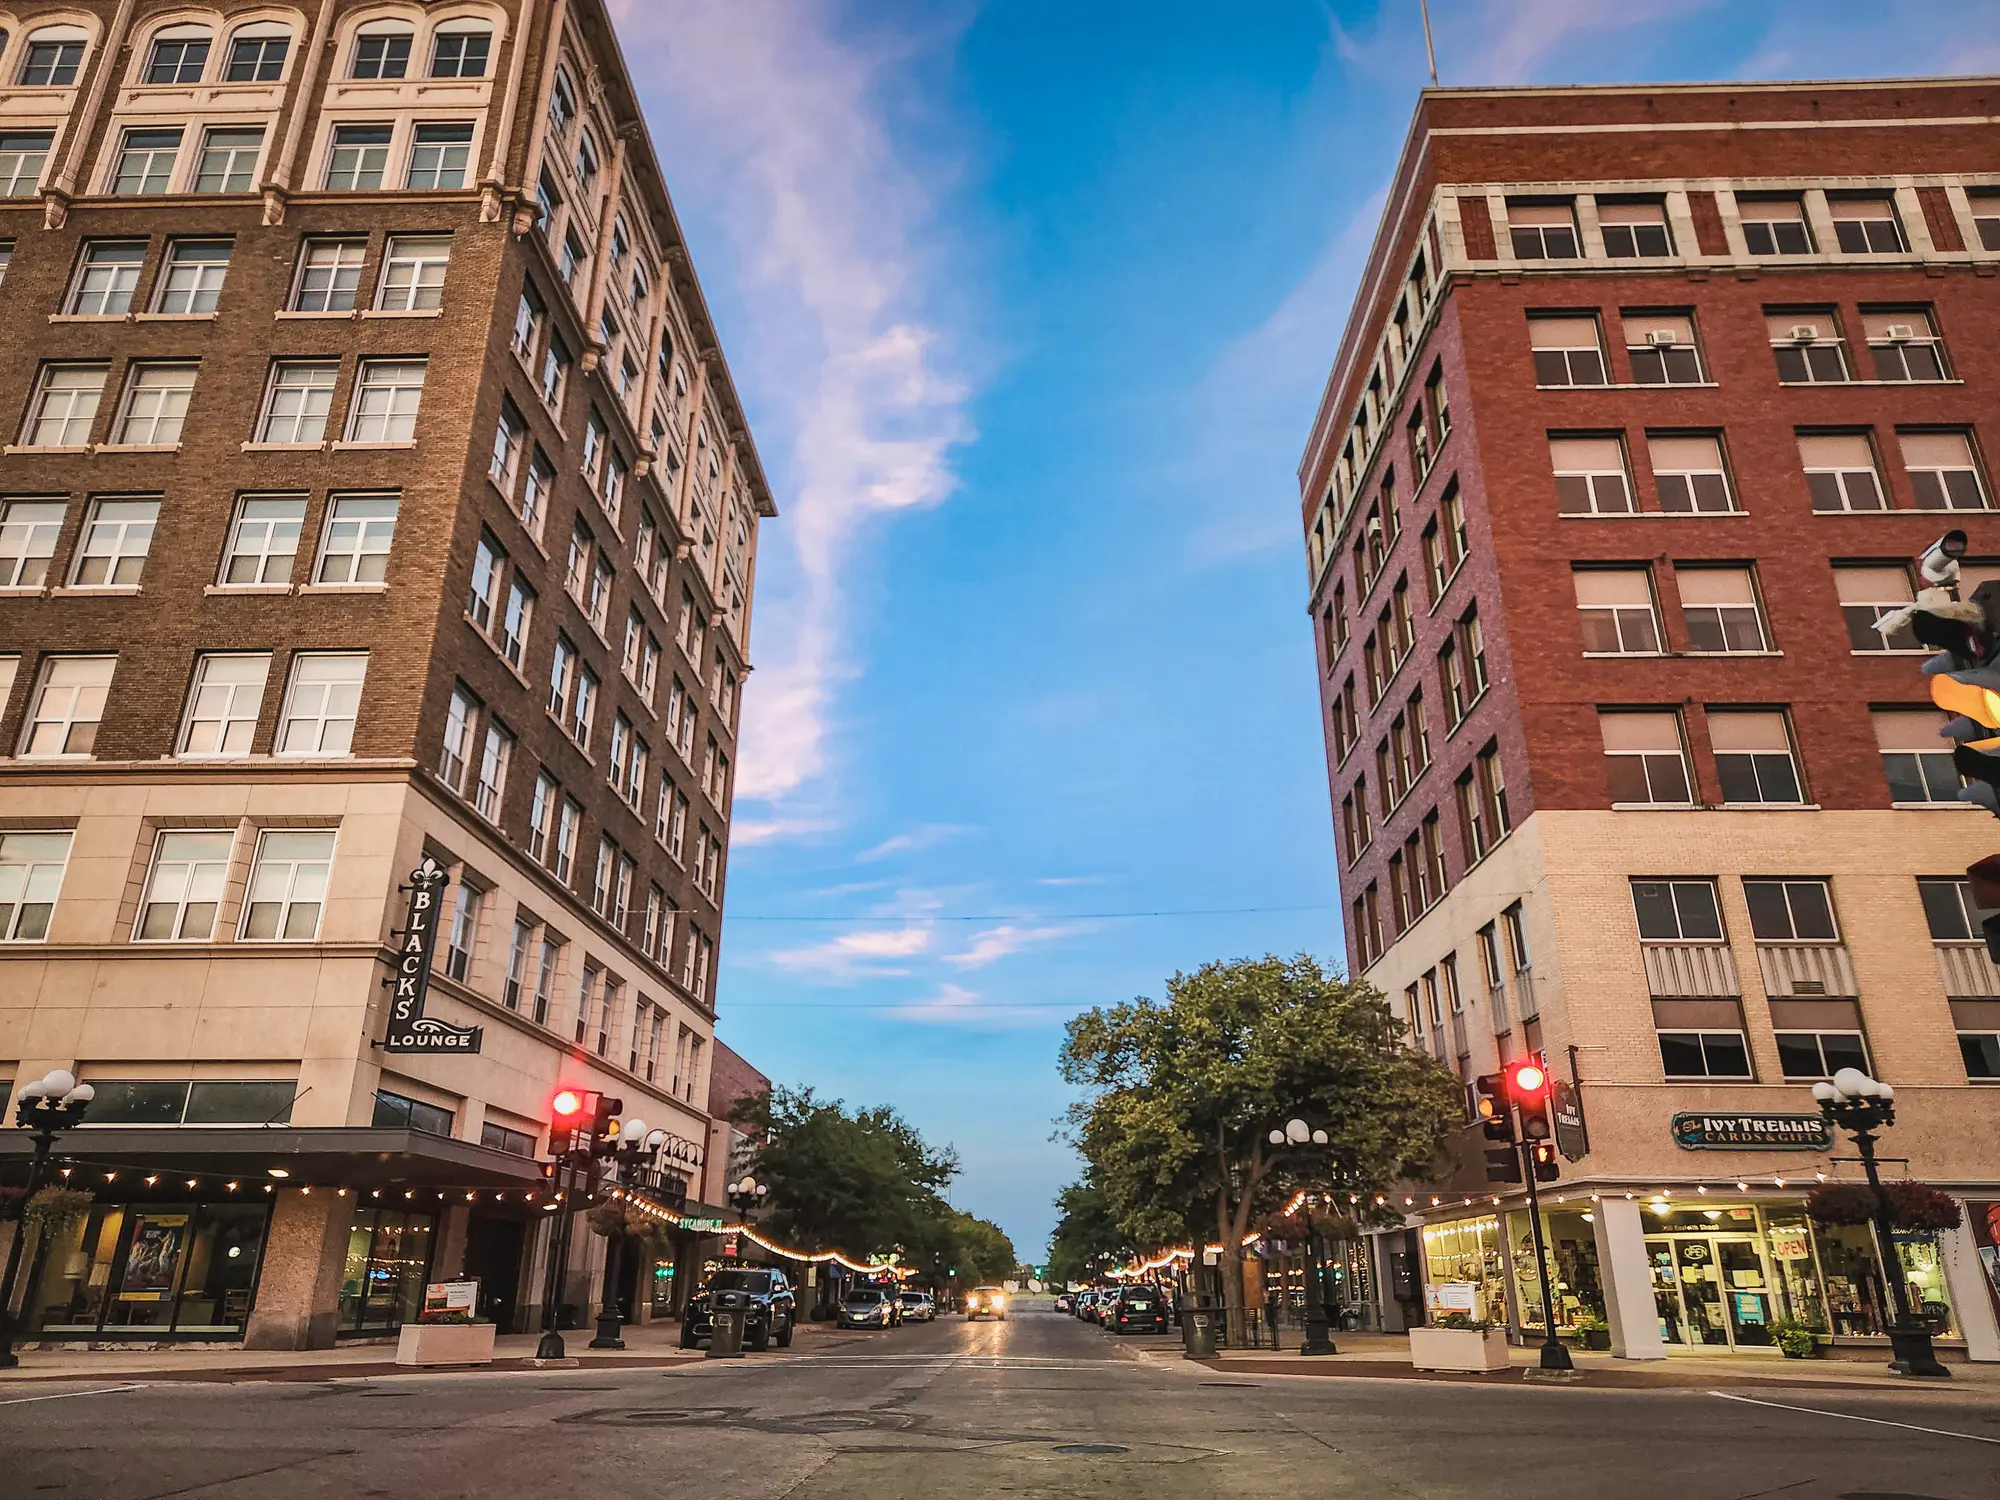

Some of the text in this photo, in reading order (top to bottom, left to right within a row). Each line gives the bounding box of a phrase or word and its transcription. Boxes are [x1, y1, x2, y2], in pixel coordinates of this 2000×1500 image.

[395, 891, 431, 1020] BLACK'S
[389, 1035, 471, 1047] LOUNGE
[1557, 1112, 1579, 1126] TRELLIS
[1738, 1118, 1823, 1132] TRELLIS
[1705, 1132, 1824, 1142] CARDS & GIFTS
[1684, 1245, 1708, 1259] OPEN
[1776, 1238, 1808, 1256] OPEN
